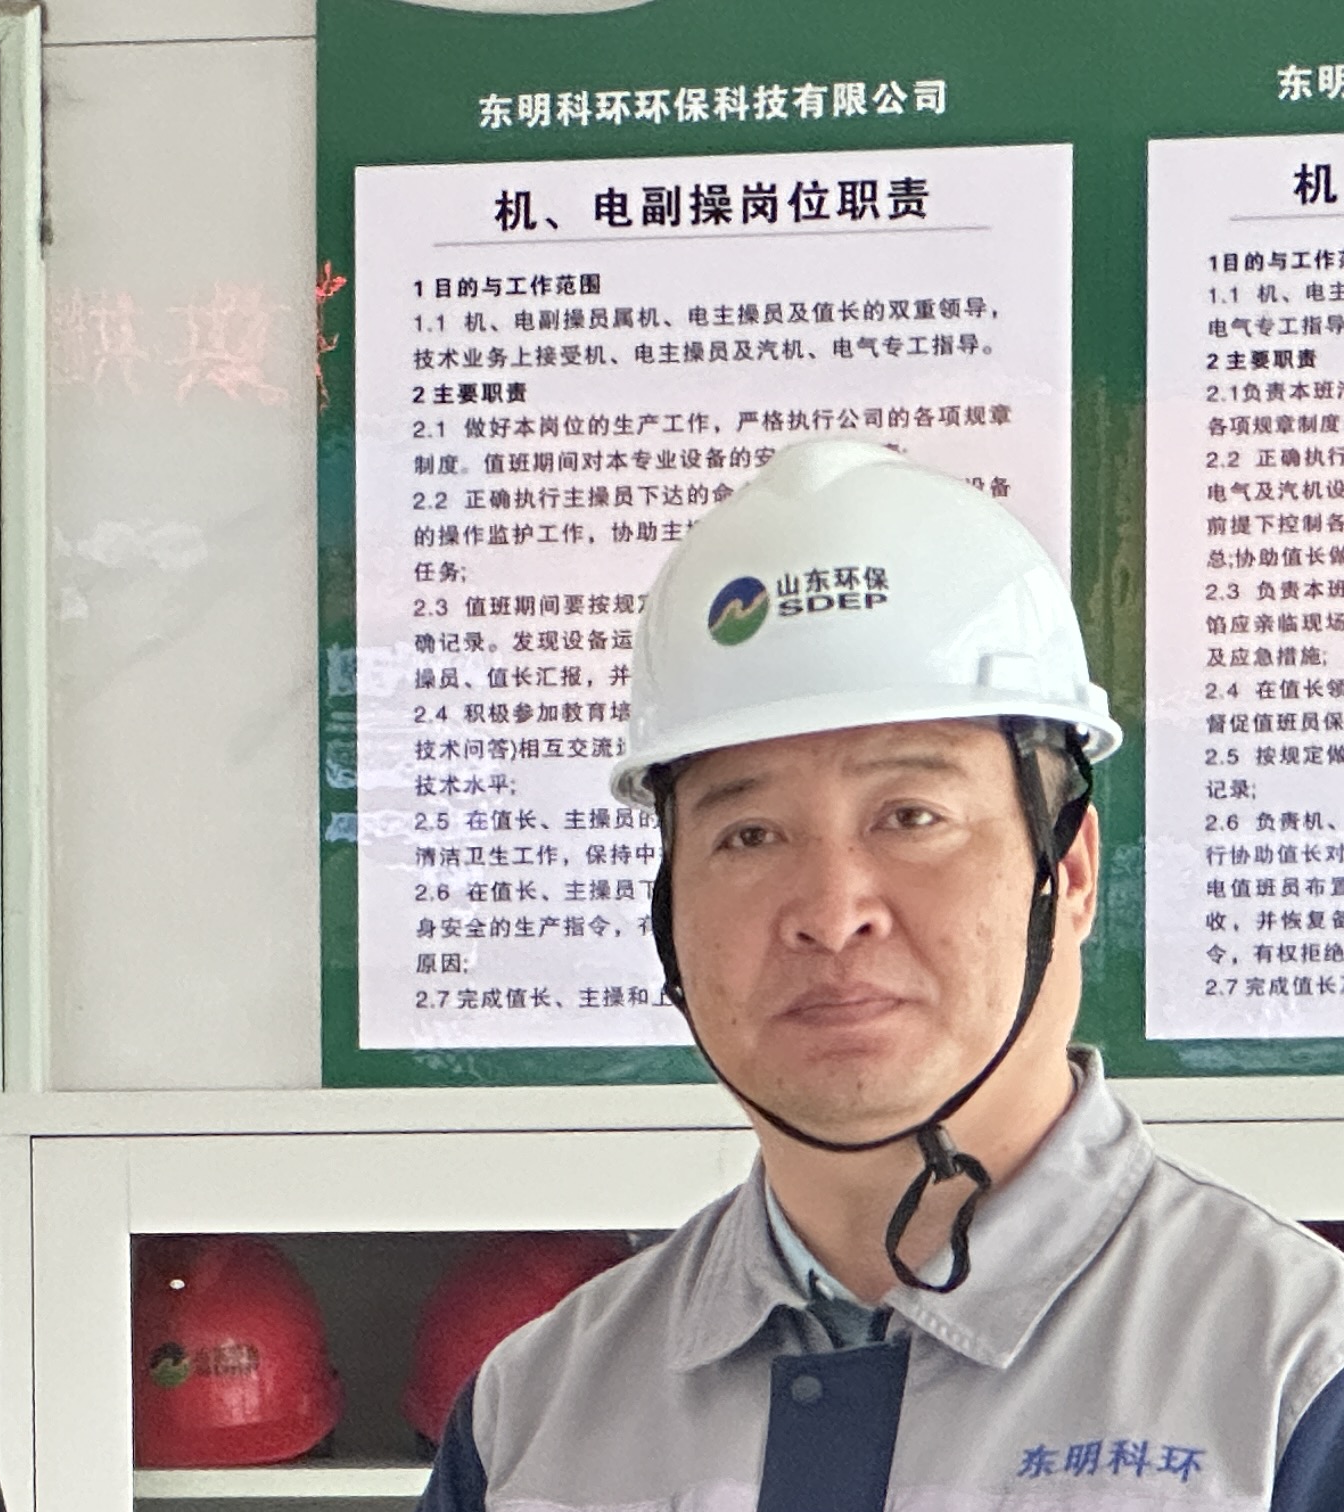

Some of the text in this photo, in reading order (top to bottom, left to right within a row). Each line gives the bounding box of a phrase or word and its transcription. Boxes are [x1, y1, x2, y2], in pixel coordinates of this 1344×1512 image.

[1277, 64, 1344, 100] 东明
[478, 80, 948, 129] 东明科环环保科技有限公司
[1293, 163, 1337, 206] 机
[494, 177, 930, 232] 机、电副操岗位职责
[435, 274, 601, 298] 目的与工作范围
[1208, 285, 1238, 304] 1.1
[413, 313, 445, 332] 1.1
[1225, 348, 1317, 370] 主要职责
[432, 382, 527, 404] 主要职责
[412, 405, 1012, 439] 2.1 做好本岗位的生产工作，严格执行公司的各项规章
[1205, 450, 1241, 469] 2.2
[412, 490, 448, 510] 2.2
[413, 520, 700, 547] 的操作监护工作，协助主
[776, 566, 889, 597] 山东环保
[1204, 582, 1240, 600] 2.3
[412, 597, 449, 617] 2.3
[777, 593, 888, 617] SDEP
[1204, 681, 1240, 699] 2.4
[413, 704, 449, 723] 2.4
[1204, 747, 1240, 766] 2.5
[414, 811, 450, 831] 2.5
[1204, 813, 1240, 831] 2.6
[415, 843, 668, 867] 清洁卫生工作，保持中
[414, 882, 451, 901] 2.6
[1245, 975, 1344, 997] 完成值长
[1016, 1440, 1207, 1484] 东明科环
